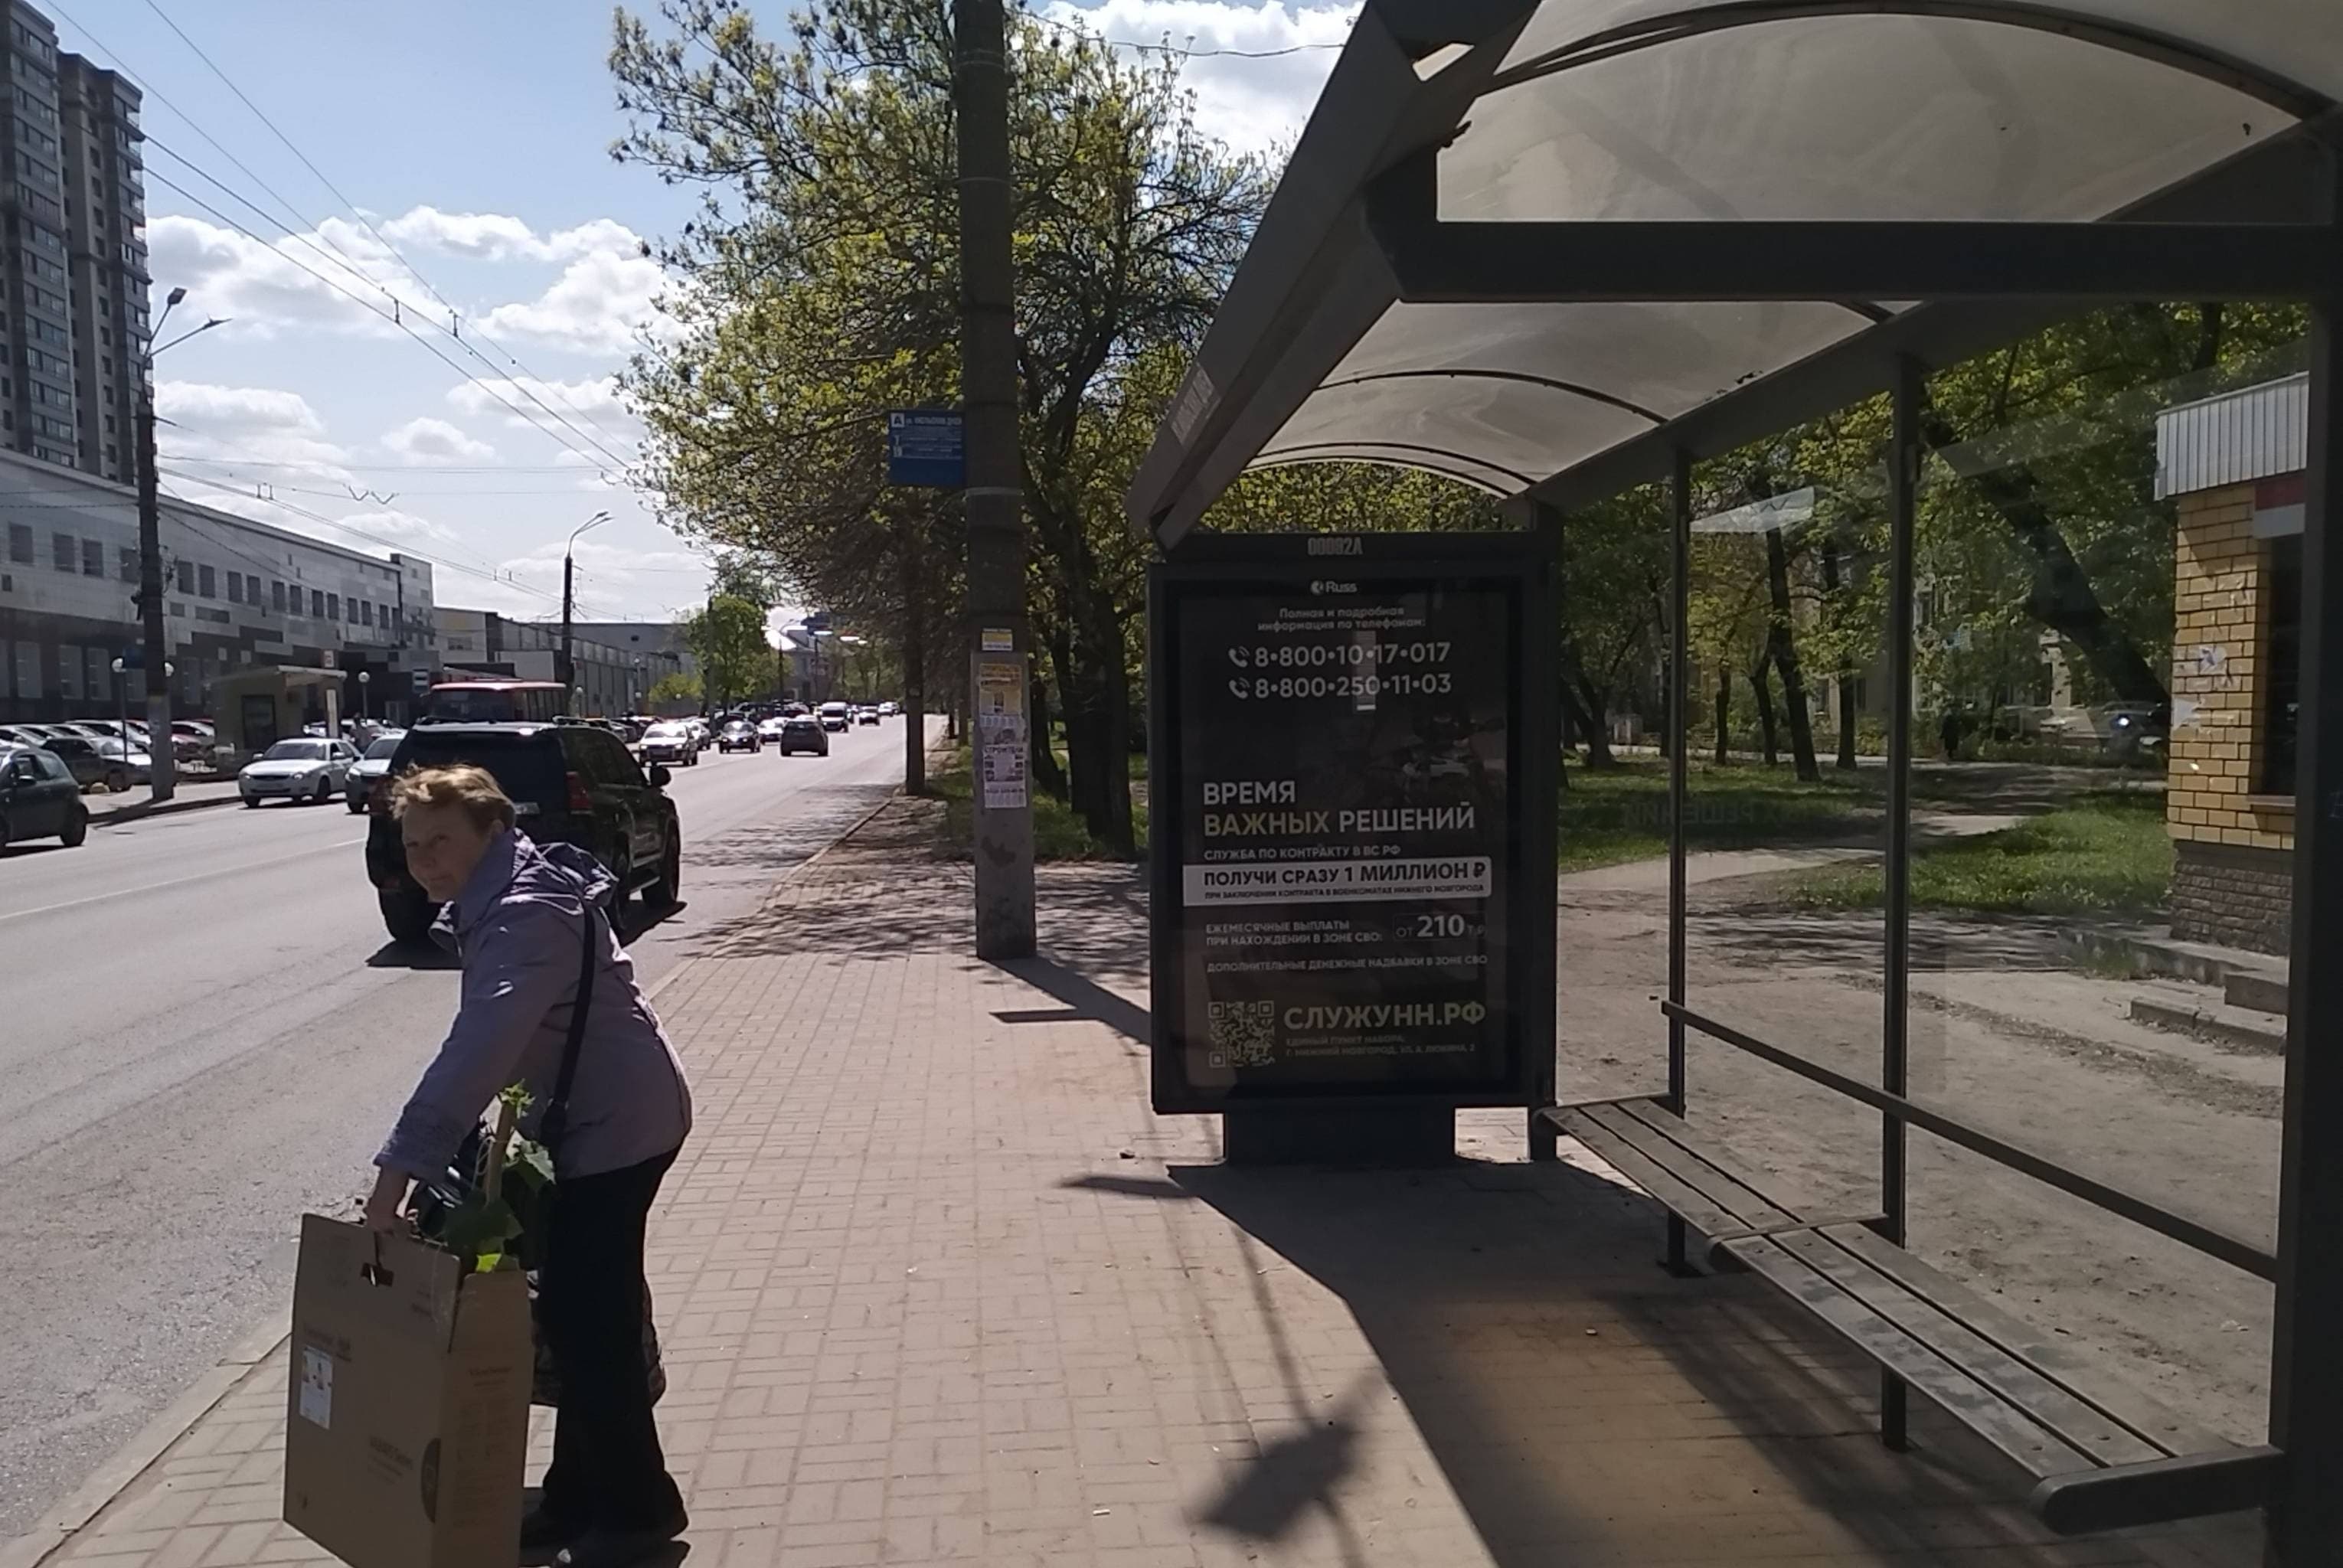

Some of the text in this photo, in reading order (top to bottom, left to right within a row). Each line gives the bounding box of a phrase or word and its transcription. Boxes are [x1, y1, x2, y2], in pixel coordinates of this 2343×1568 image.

[1325, 580, 1358, 593] Russ
[1279, 606, 1404, 619] Полная и подробная
[1257, 620, 1334, 633] информация
[1338, 621, 1352, 629] по
[1204, 781, 1296, 805] ВРЕМЯ
[1204, 801, 1475, 837] ВАЖНЫХ РЕШЕНИЙ
[1204, 844, 1401, 861] СЛУЖБА ПО КОНТРАКТУ В ВС РФ
[1204, 871, 1276, 886] ПОЛУЧИ
[1283, 868, 1338, 884] СРАЗУ
[1344, 867, 1353, 882] 1
[1361, 863, 1468, 882] МИЛЛИОН
[1434, 884, 1483, 893] НОВГОРОДА
[1207, 920, 1349, 933] ЕЖЕМЕСЯЧНЫЕ ВЫПЛАТЫ
[1417, 913, 1466, 938] 210
[1207, 936, 1228, 946] ПРИ
[1231, 935, 1311, 946] НАХОЖДЕНИИ
[1313, 934, 1320, 943] В
[1322, 933, 1353, 943] ЗОНЕ
[1207, 954, 1488, 972] ДОПОЛНИТЕЛЬНЫЕ ДЕНЕЖНЫЕ НАДБАВКИ В ЗОНЕ СВО
[1284, 1001, 1486, 1030] СЛУЖУНН.РФ
